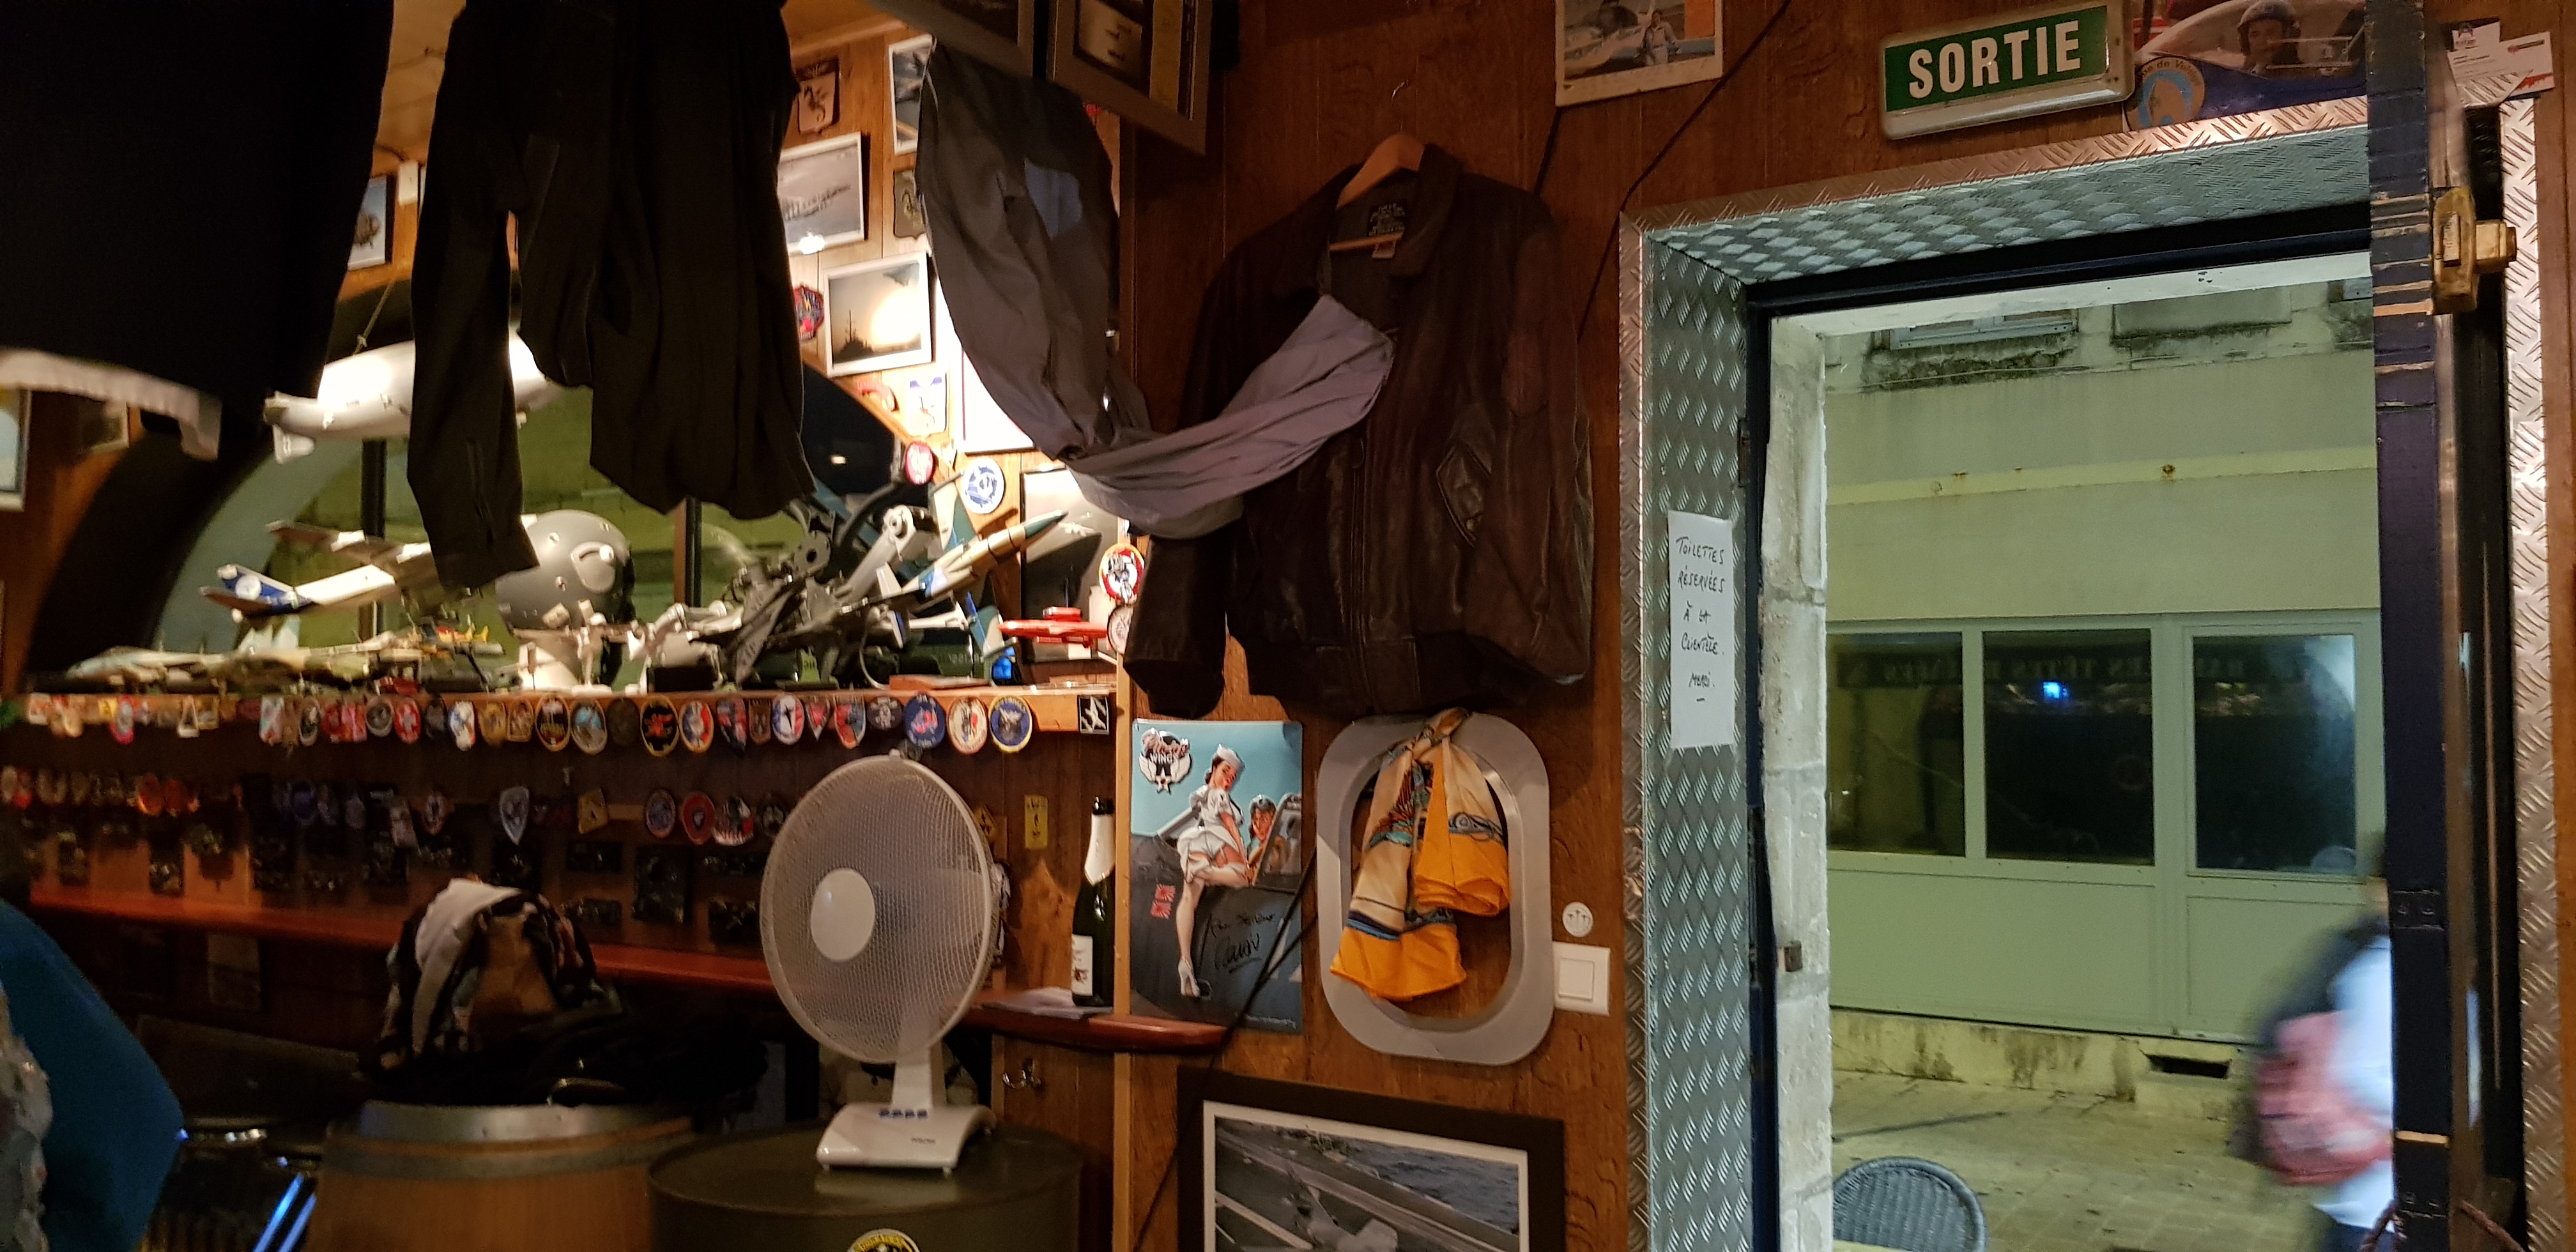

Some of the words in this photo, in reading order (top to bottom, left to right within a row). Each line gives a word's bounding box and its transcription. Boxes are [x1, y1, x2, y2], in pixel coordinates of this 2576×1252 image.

[1909, 20, 2081, 98] SORTIE
[1675, 536, 1724, 565] TOILETTES
[1677, 565, 1726, 593] RÉSERVÉES
[1683, 600, 1693, 622] À
[1698, 609, 1712, 624] LA
